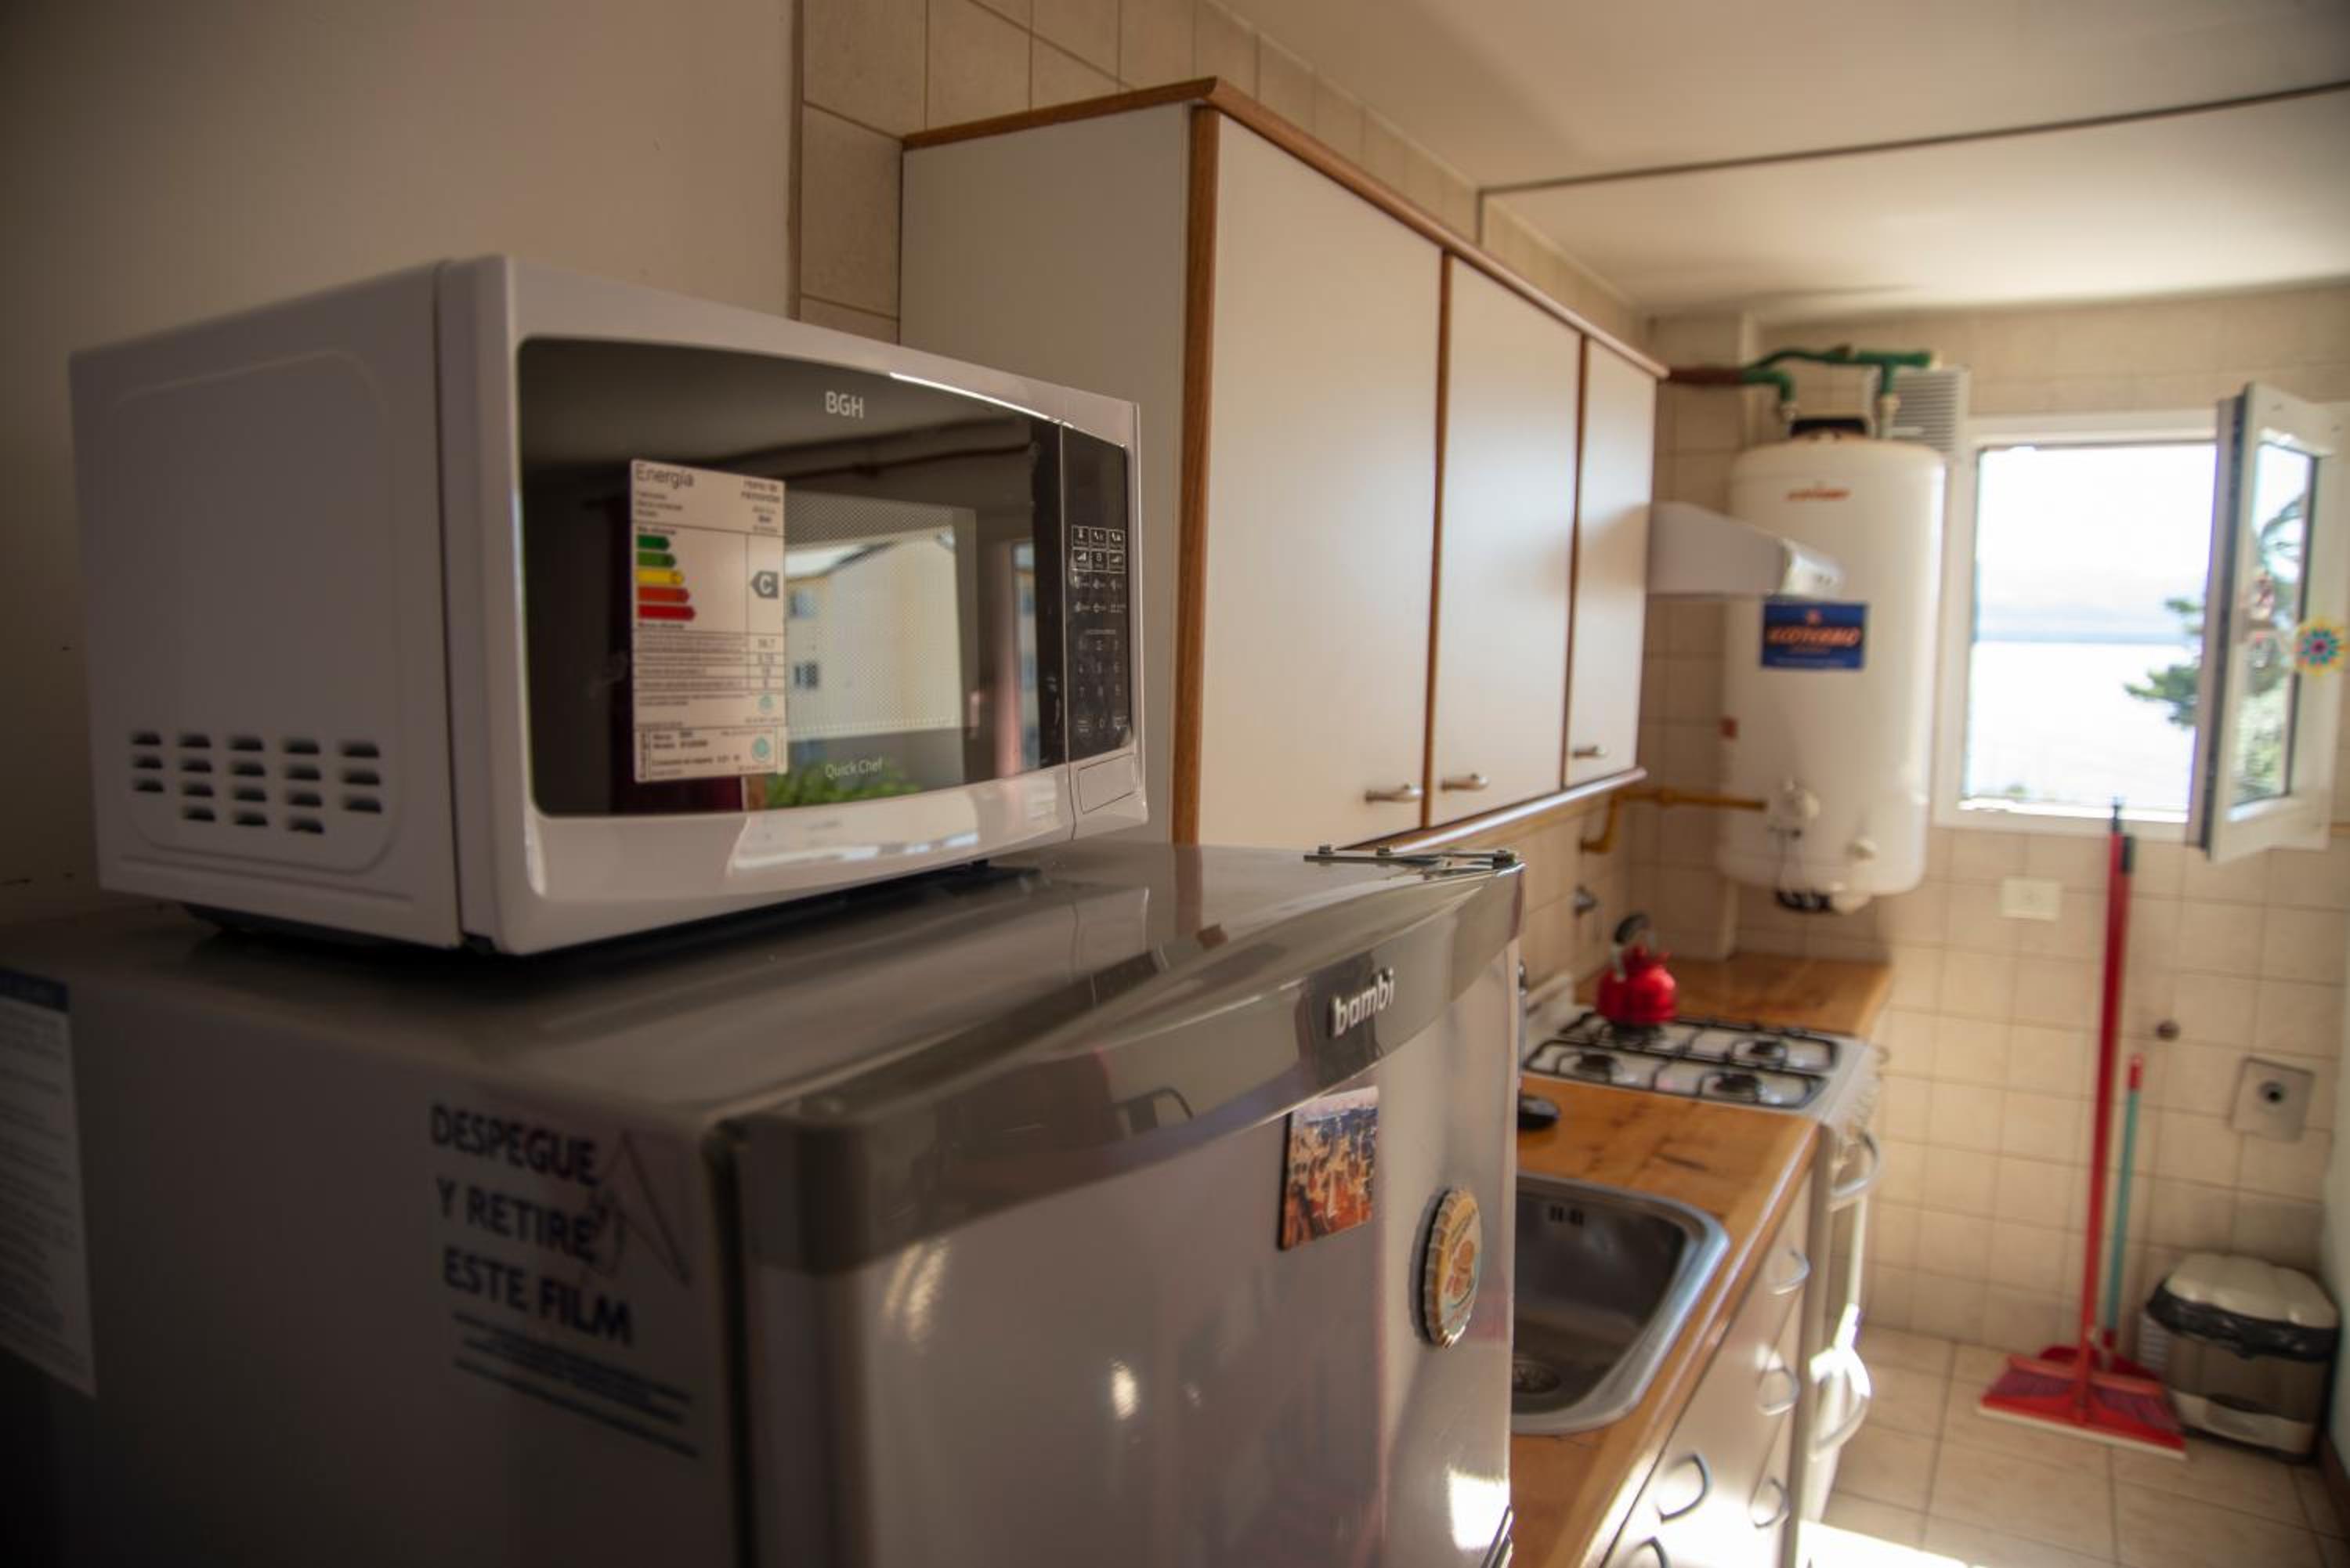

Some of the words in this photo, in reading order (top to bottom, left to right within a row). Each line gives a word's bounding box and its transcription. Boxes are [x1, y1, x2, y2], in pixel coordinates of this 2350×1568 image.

[825, 390, 864, 419] BGH
[758, 574, 773, 595] C
[1334, 967, 1394, 1037] bambi
[432, 1103, 601, 1186] DESPEGUE
[436, 1175, 457, 1219] Y
[468, 1183, 603, 1265] RETIRE
[443, 1244, 529, 1314] ESTE
[540, 1276, 634, 1345] FILM
